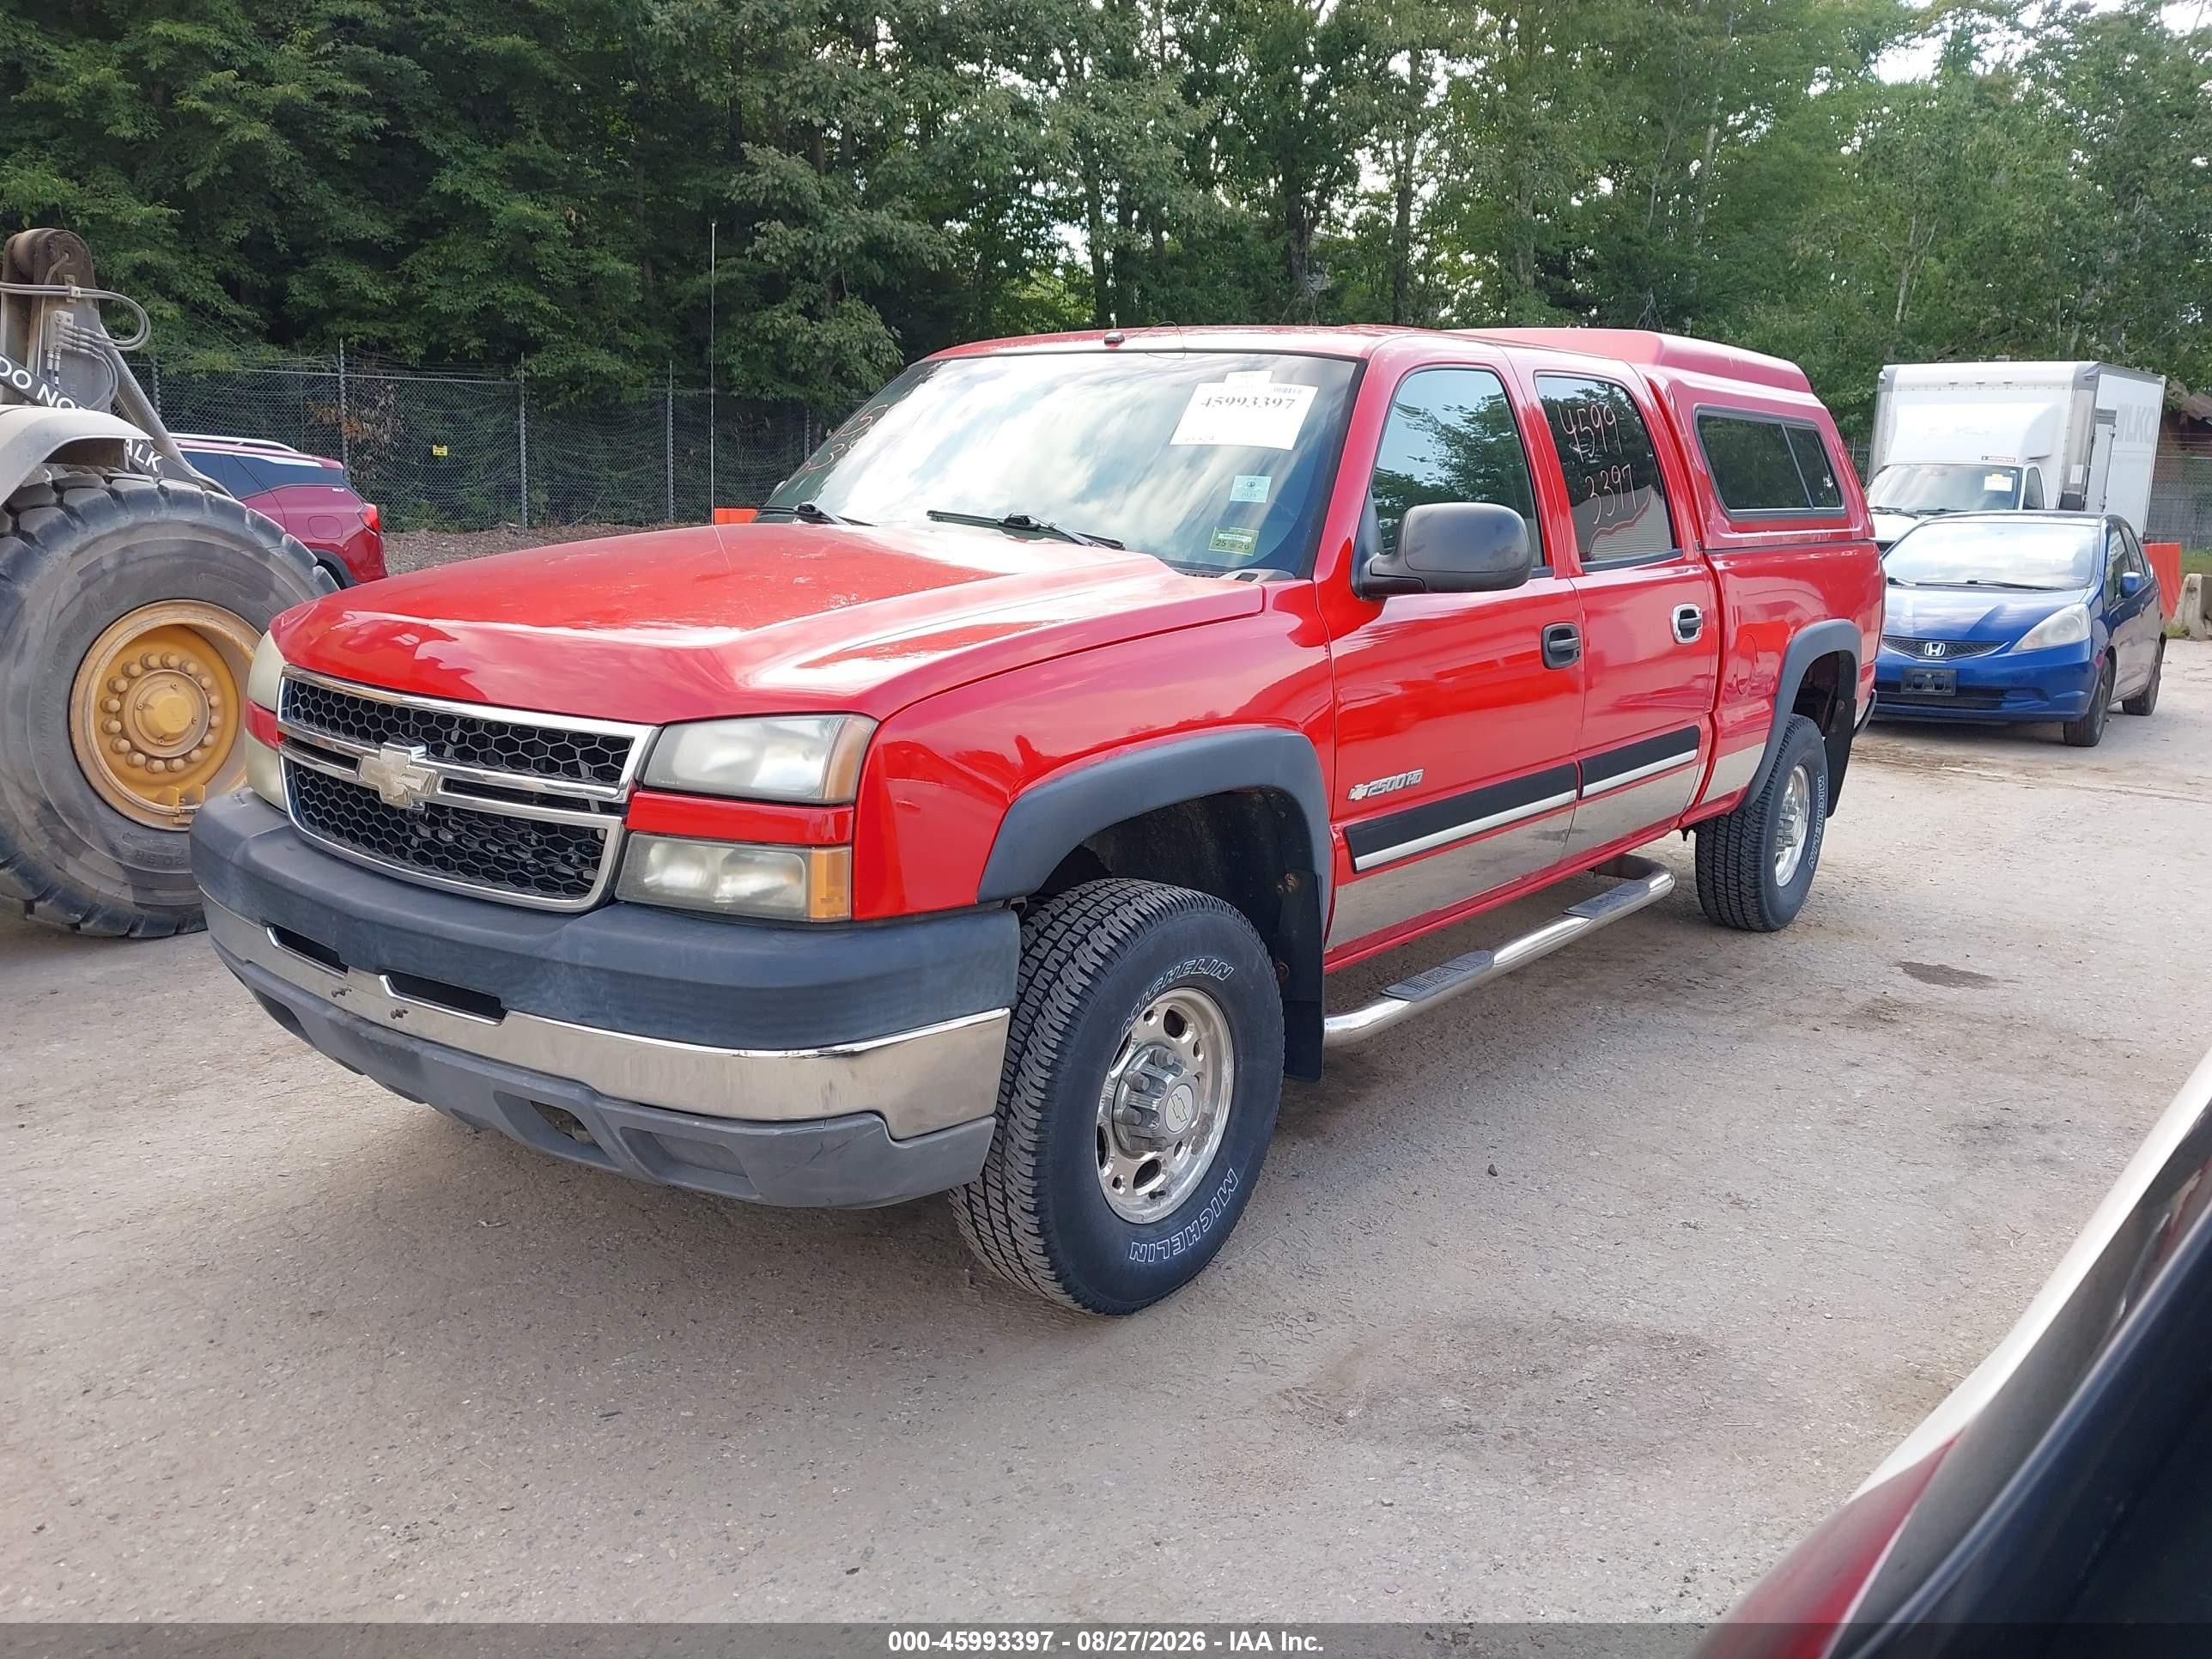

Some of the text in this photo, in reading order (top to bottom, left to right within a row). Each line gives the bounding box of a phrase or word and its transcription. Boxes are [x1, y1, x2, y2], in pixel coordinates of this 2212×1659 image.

[1201, 396, 1296, 410] 45993397
[1557, 404, 1623, 464] 4599
[1584, 463, 1637, 525] 3397
[1808, 775, 1826, 870] MICHELIN
[1121, 958, 1235, 1042] MICHELIN
[1128, 1167, 1239, 1263] MICHELIN
